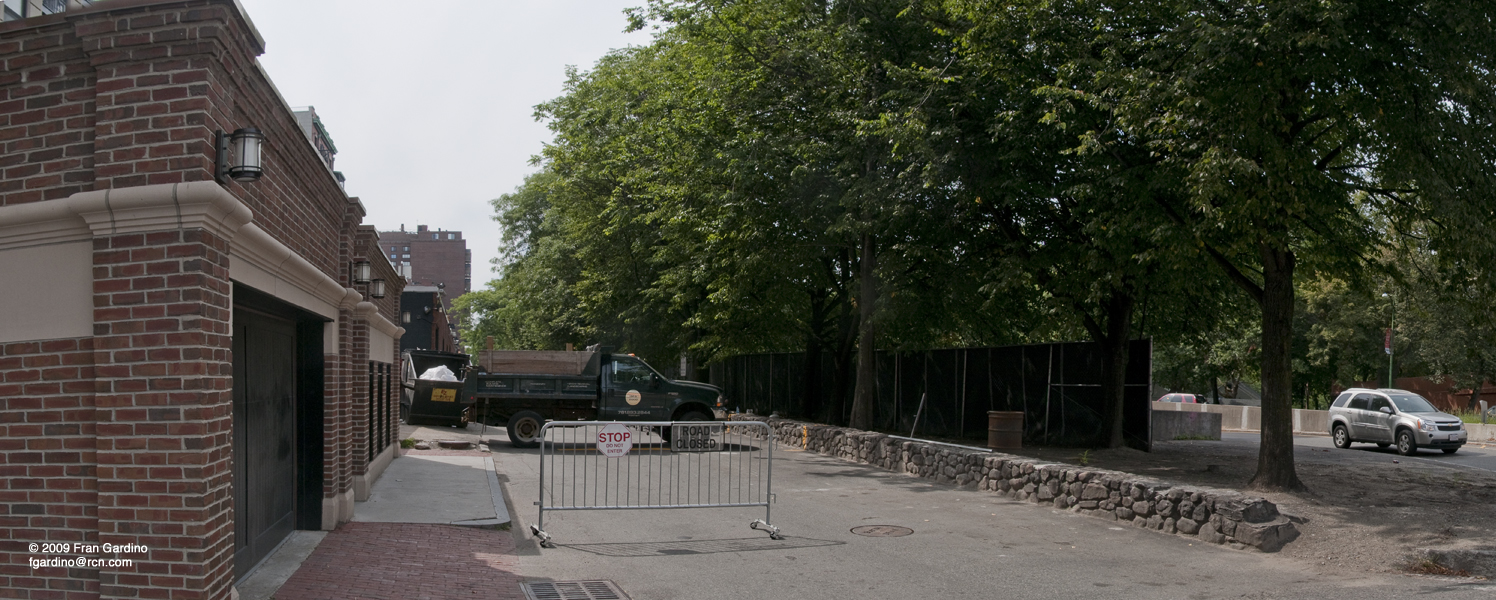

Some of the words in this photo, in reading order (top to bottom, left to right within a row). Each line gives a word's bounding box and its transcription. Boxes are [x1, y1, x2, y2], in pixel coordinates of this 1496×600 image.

[682, 425, 710, 436] ROAD
[599, 432, 631, 443] STOP
[676, 438, 716, 449] CLOSED
